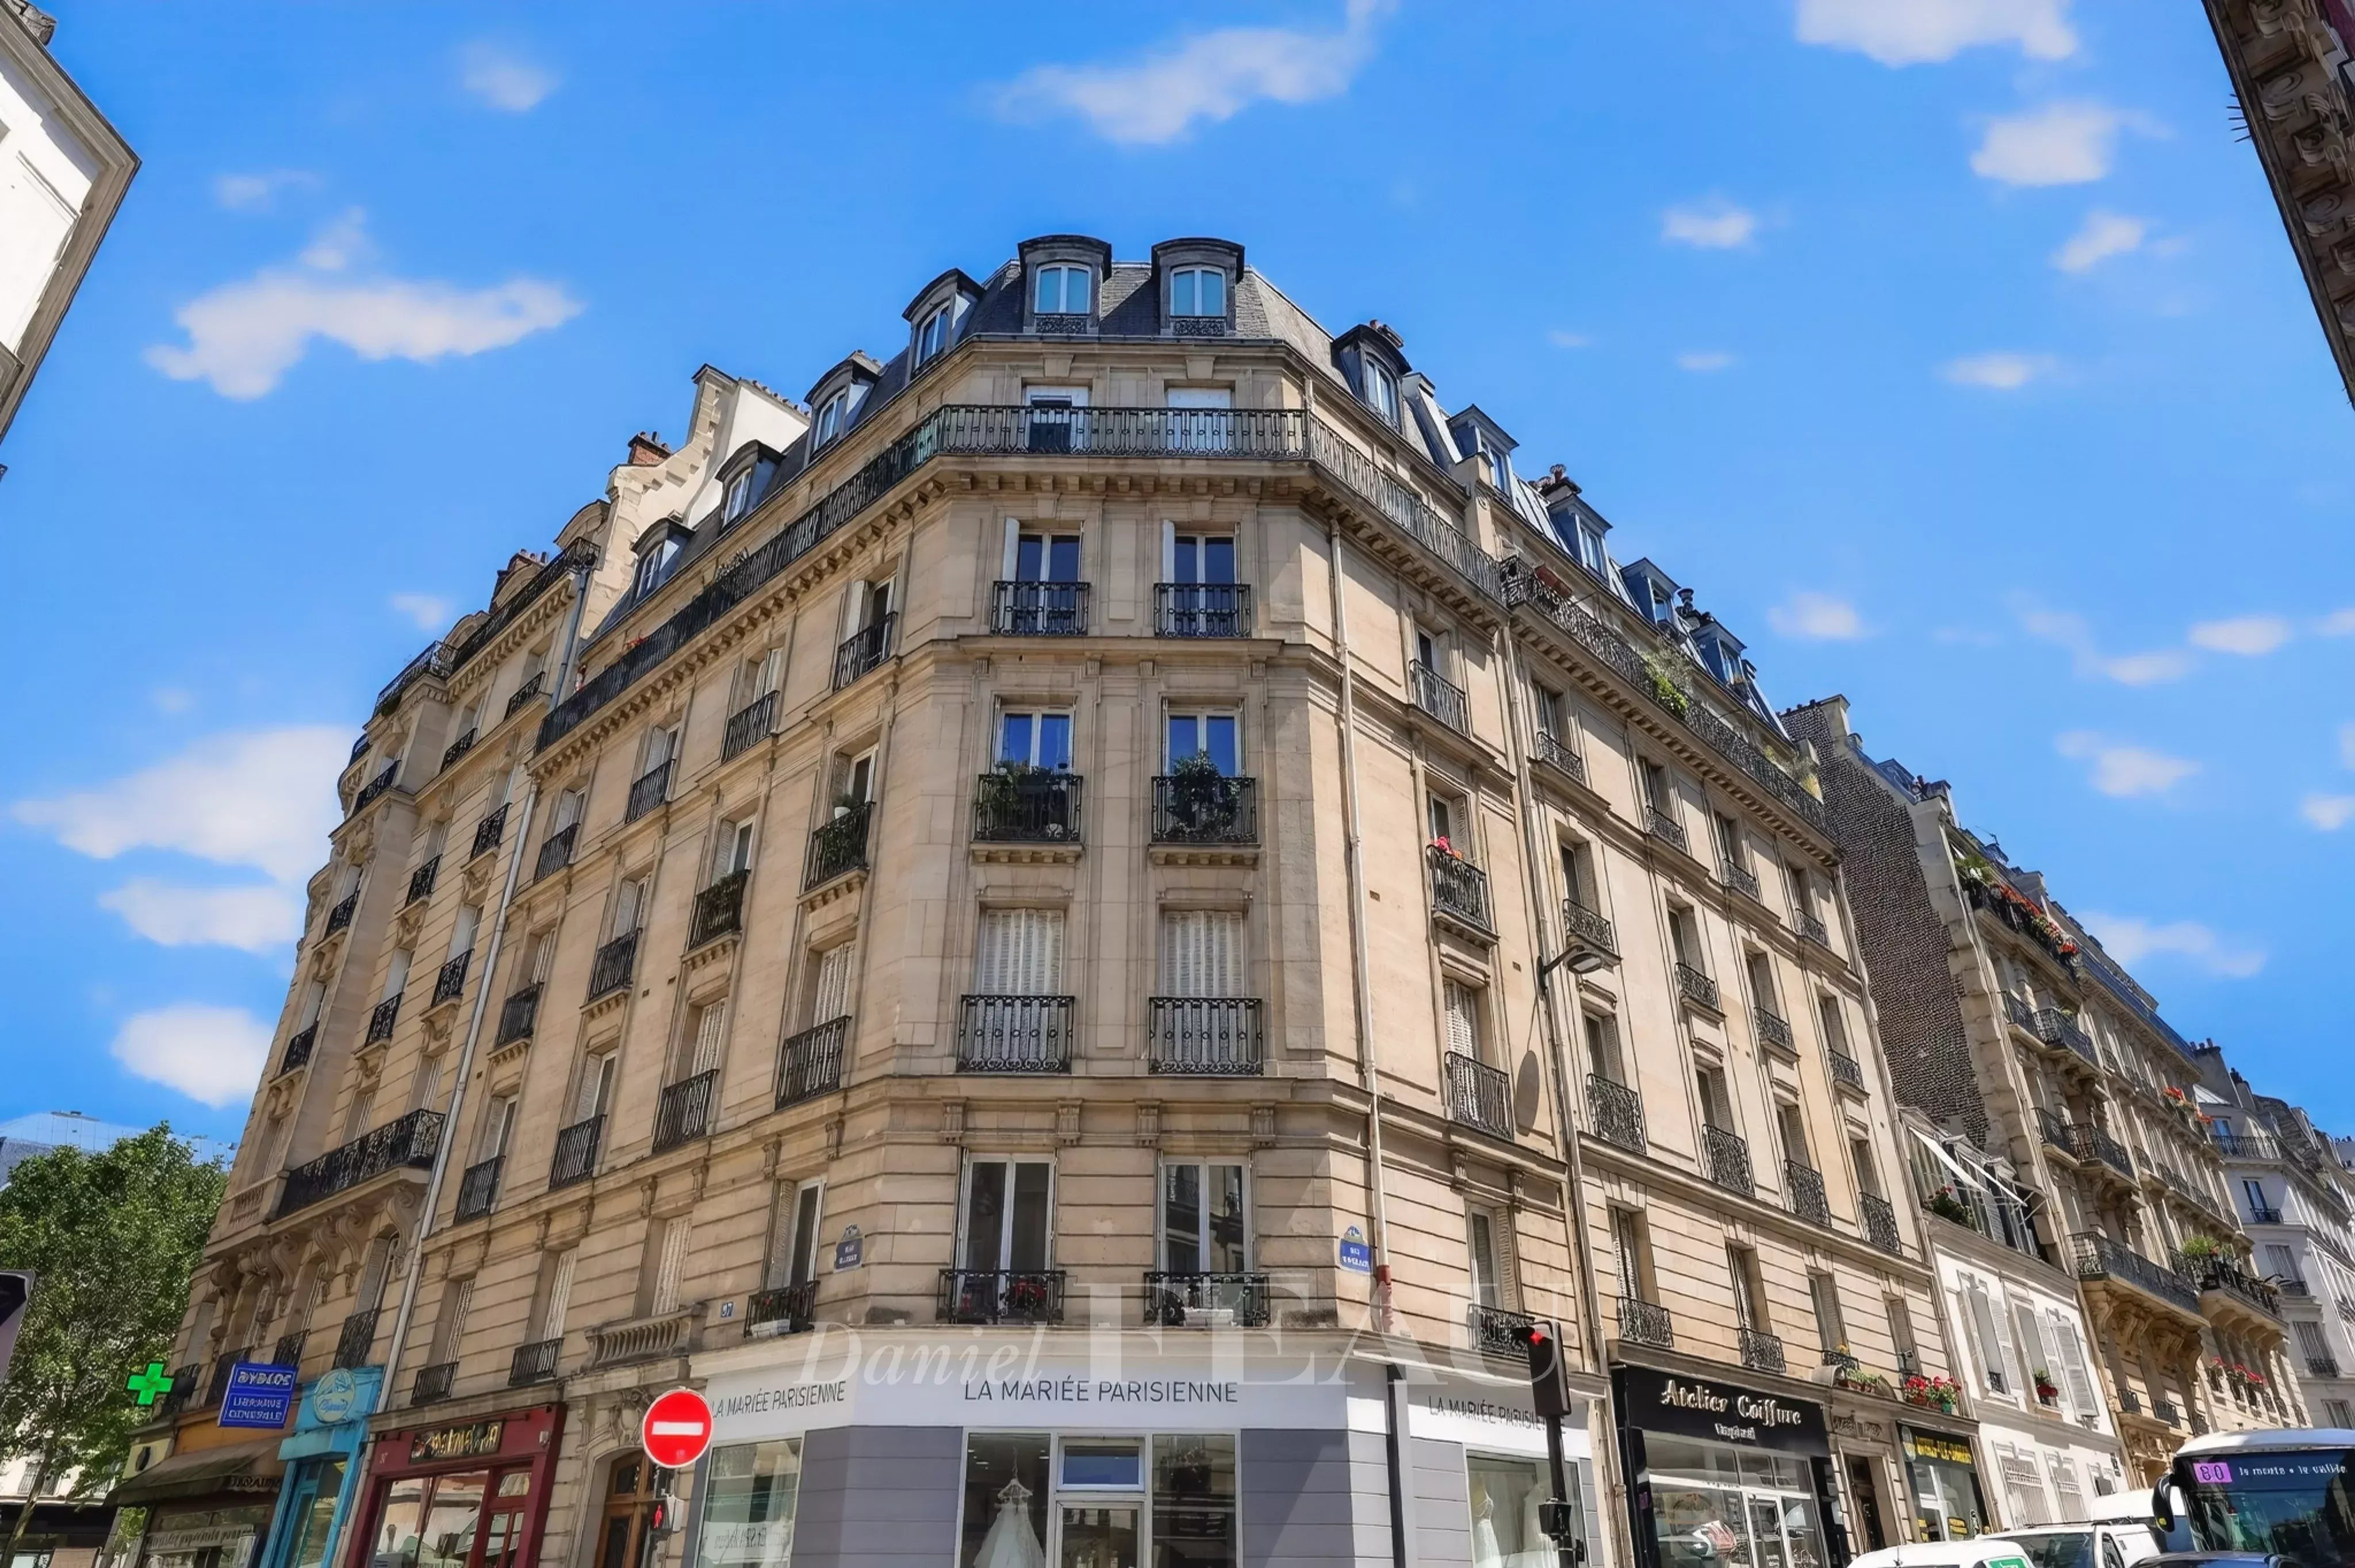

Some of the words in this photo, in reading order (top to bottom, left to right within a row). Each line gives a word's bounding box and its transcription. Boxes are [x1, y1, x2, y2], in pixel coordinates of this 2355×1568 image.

[711, 1397, 724, 1418] LA
[727, 1388, 770, 1417] MARIÉE
[772, 1381, 846, 1410] PARISIENNE
[964, 1380, 993, 1401] LA
[1002, 1375, 1089, 1401] MARIÉE
[1098, 1381, 1238, 1402] PARISIENNE
[1429, 1396, 1445, 1416] LA
[1660, 1379, 1728, 1412] Atelier
[1737, 1395, 1802, 1427] Coiffure
[2200, 1465, 2224, 1481] 80
